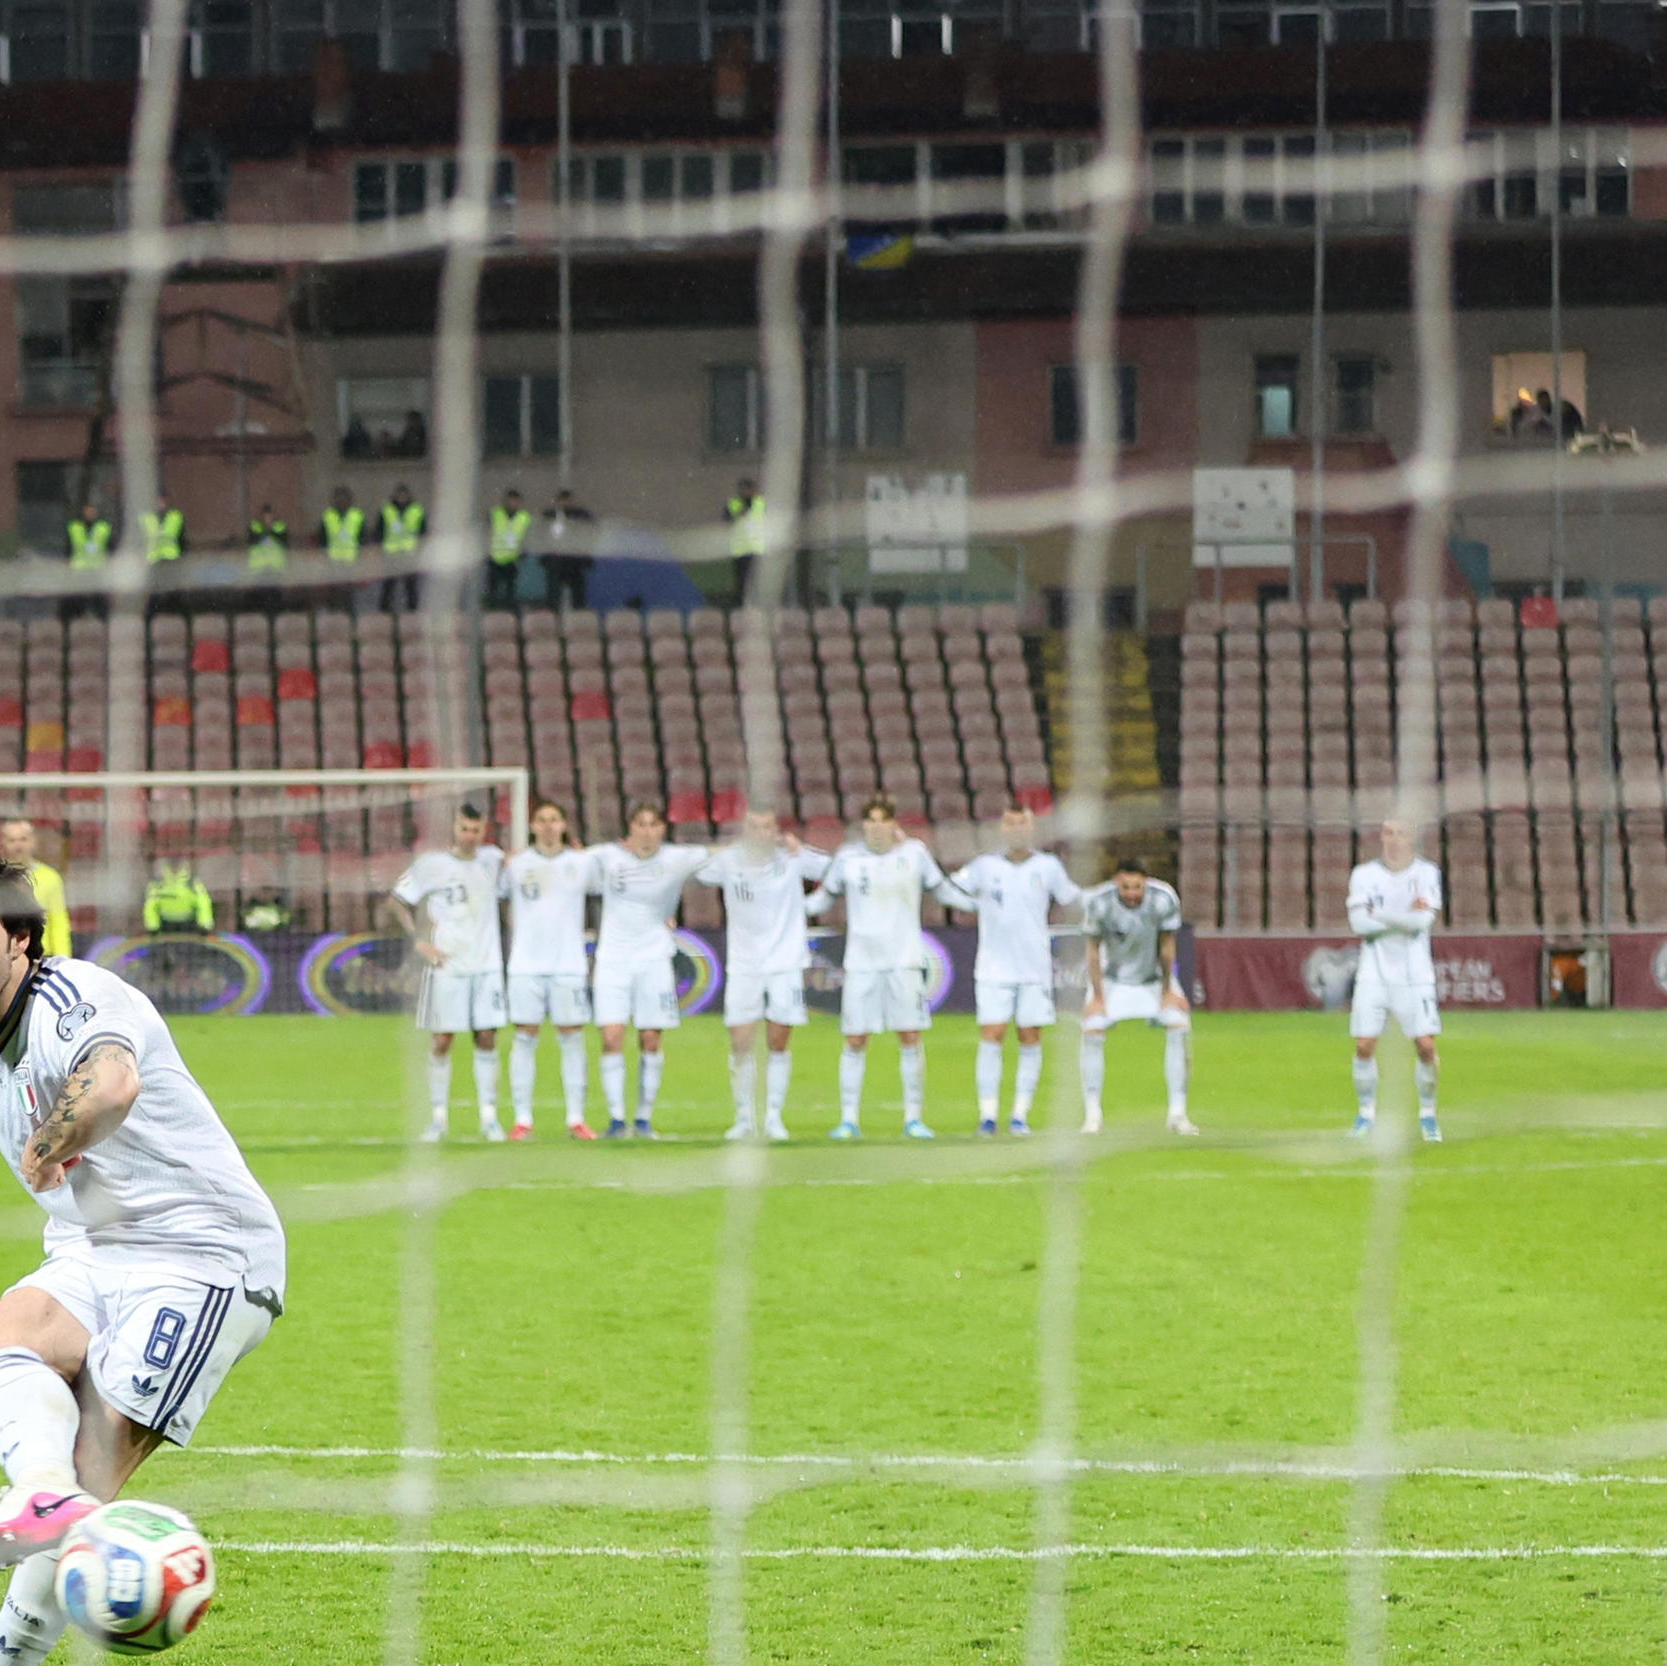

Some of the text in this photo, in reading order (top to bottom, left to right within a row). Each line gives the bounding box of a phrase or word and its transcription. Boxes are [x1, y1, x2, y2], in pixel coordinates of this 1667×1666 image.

[1437, 979, 1506, 1003] FIERS
[143, 1306, 187, 1370] 8
[6, 1595, 46, 1627] ALIA
